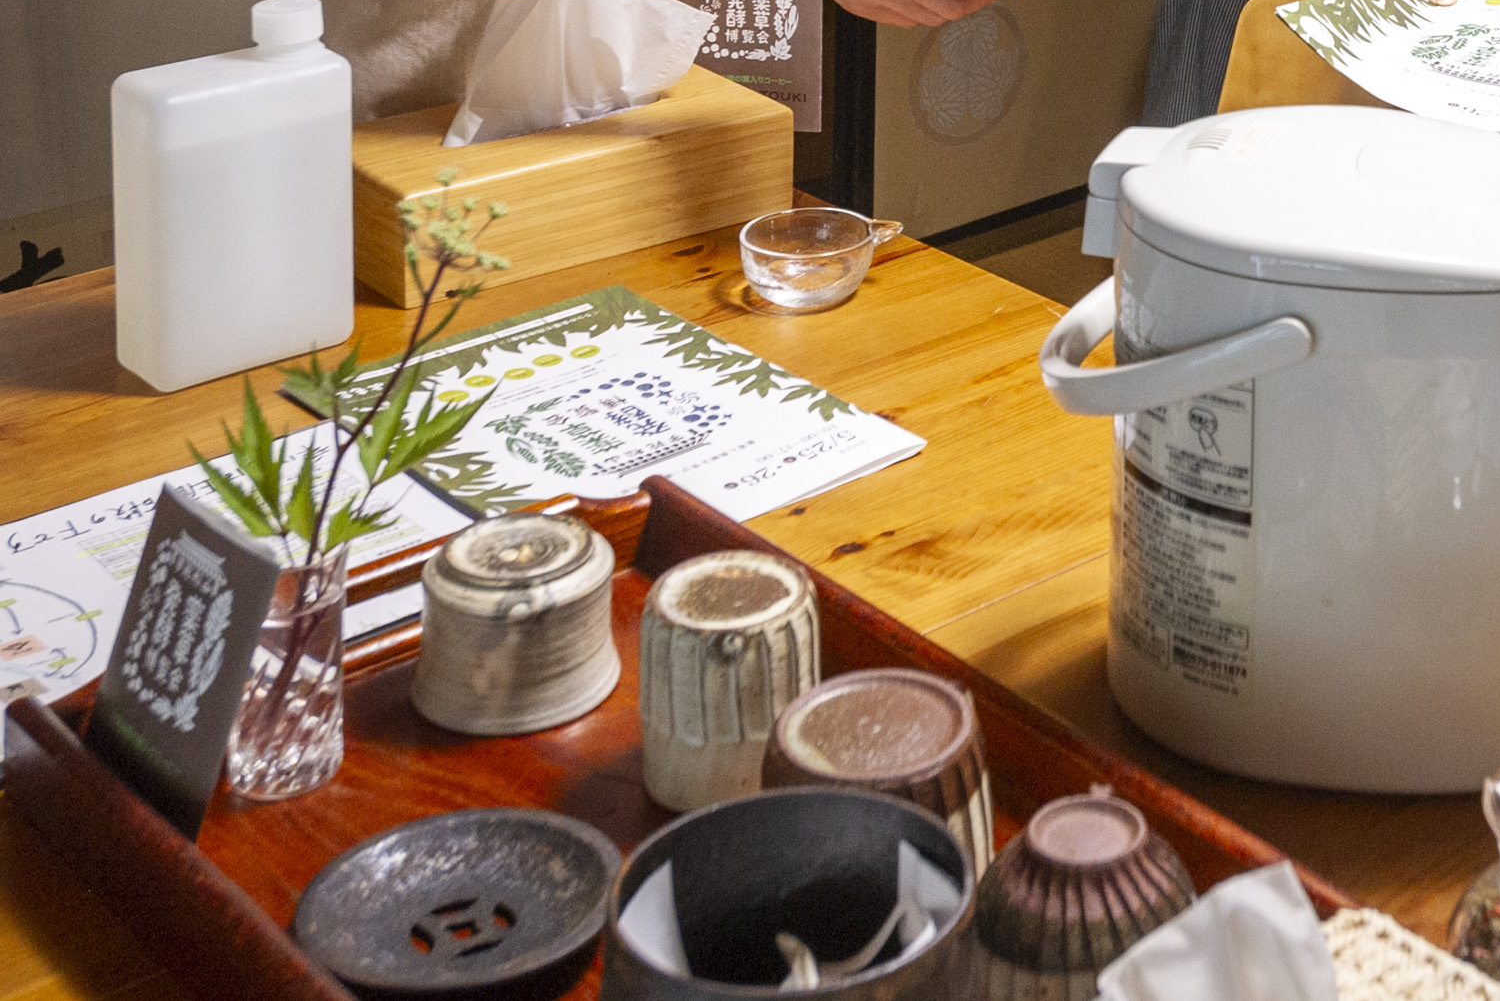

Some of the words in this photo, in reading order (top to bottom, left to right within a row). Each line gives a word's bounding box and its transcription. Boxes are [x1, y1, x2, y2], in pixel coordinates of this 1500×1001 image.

[724, 29, 770, 45] 博覧会
[603, 405, 671, 437] 発酵
